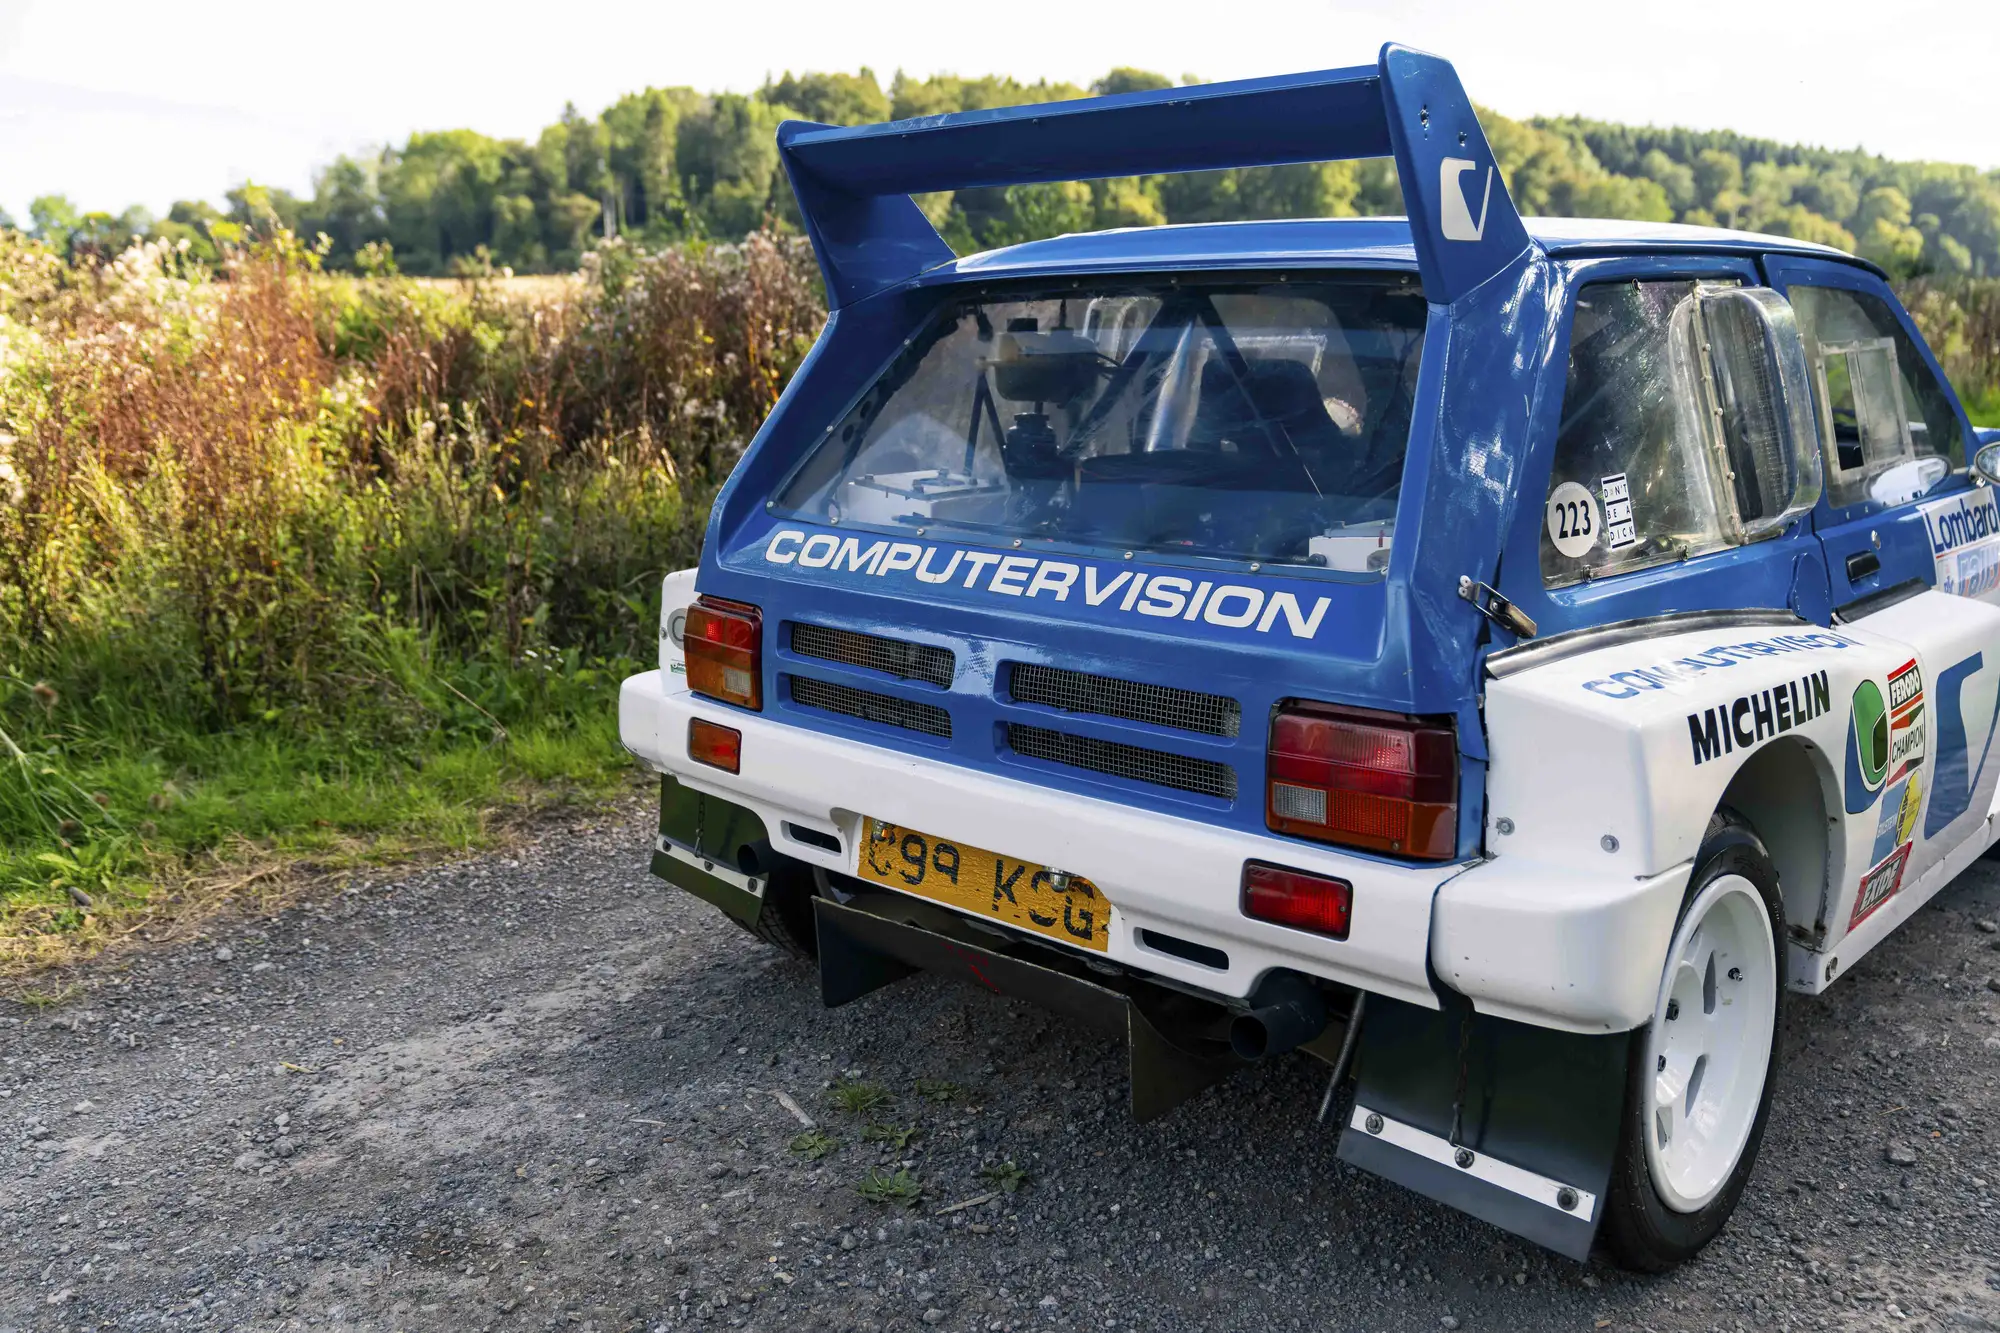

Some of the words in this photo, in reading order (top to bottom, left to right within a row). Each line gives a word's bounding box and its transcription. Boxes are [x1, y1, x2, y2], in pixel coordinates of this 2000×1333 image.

[1555, 500, 1591, 539] 223
[1607, 508, 1617, 520] BE
[1609, 526, 1634, 541] DICK
[1923, 488, 2000, 553] Lombard
[764, 530, 1332, 640] COMPUTERVISION
[1890, 669, 1920, 707] FERODO
[1686, 669, 1831, 766] MICHELIN
[1891, 724, 1924, 764] CHAMPION
[1859, 858, 1901, 912] EXIDE
